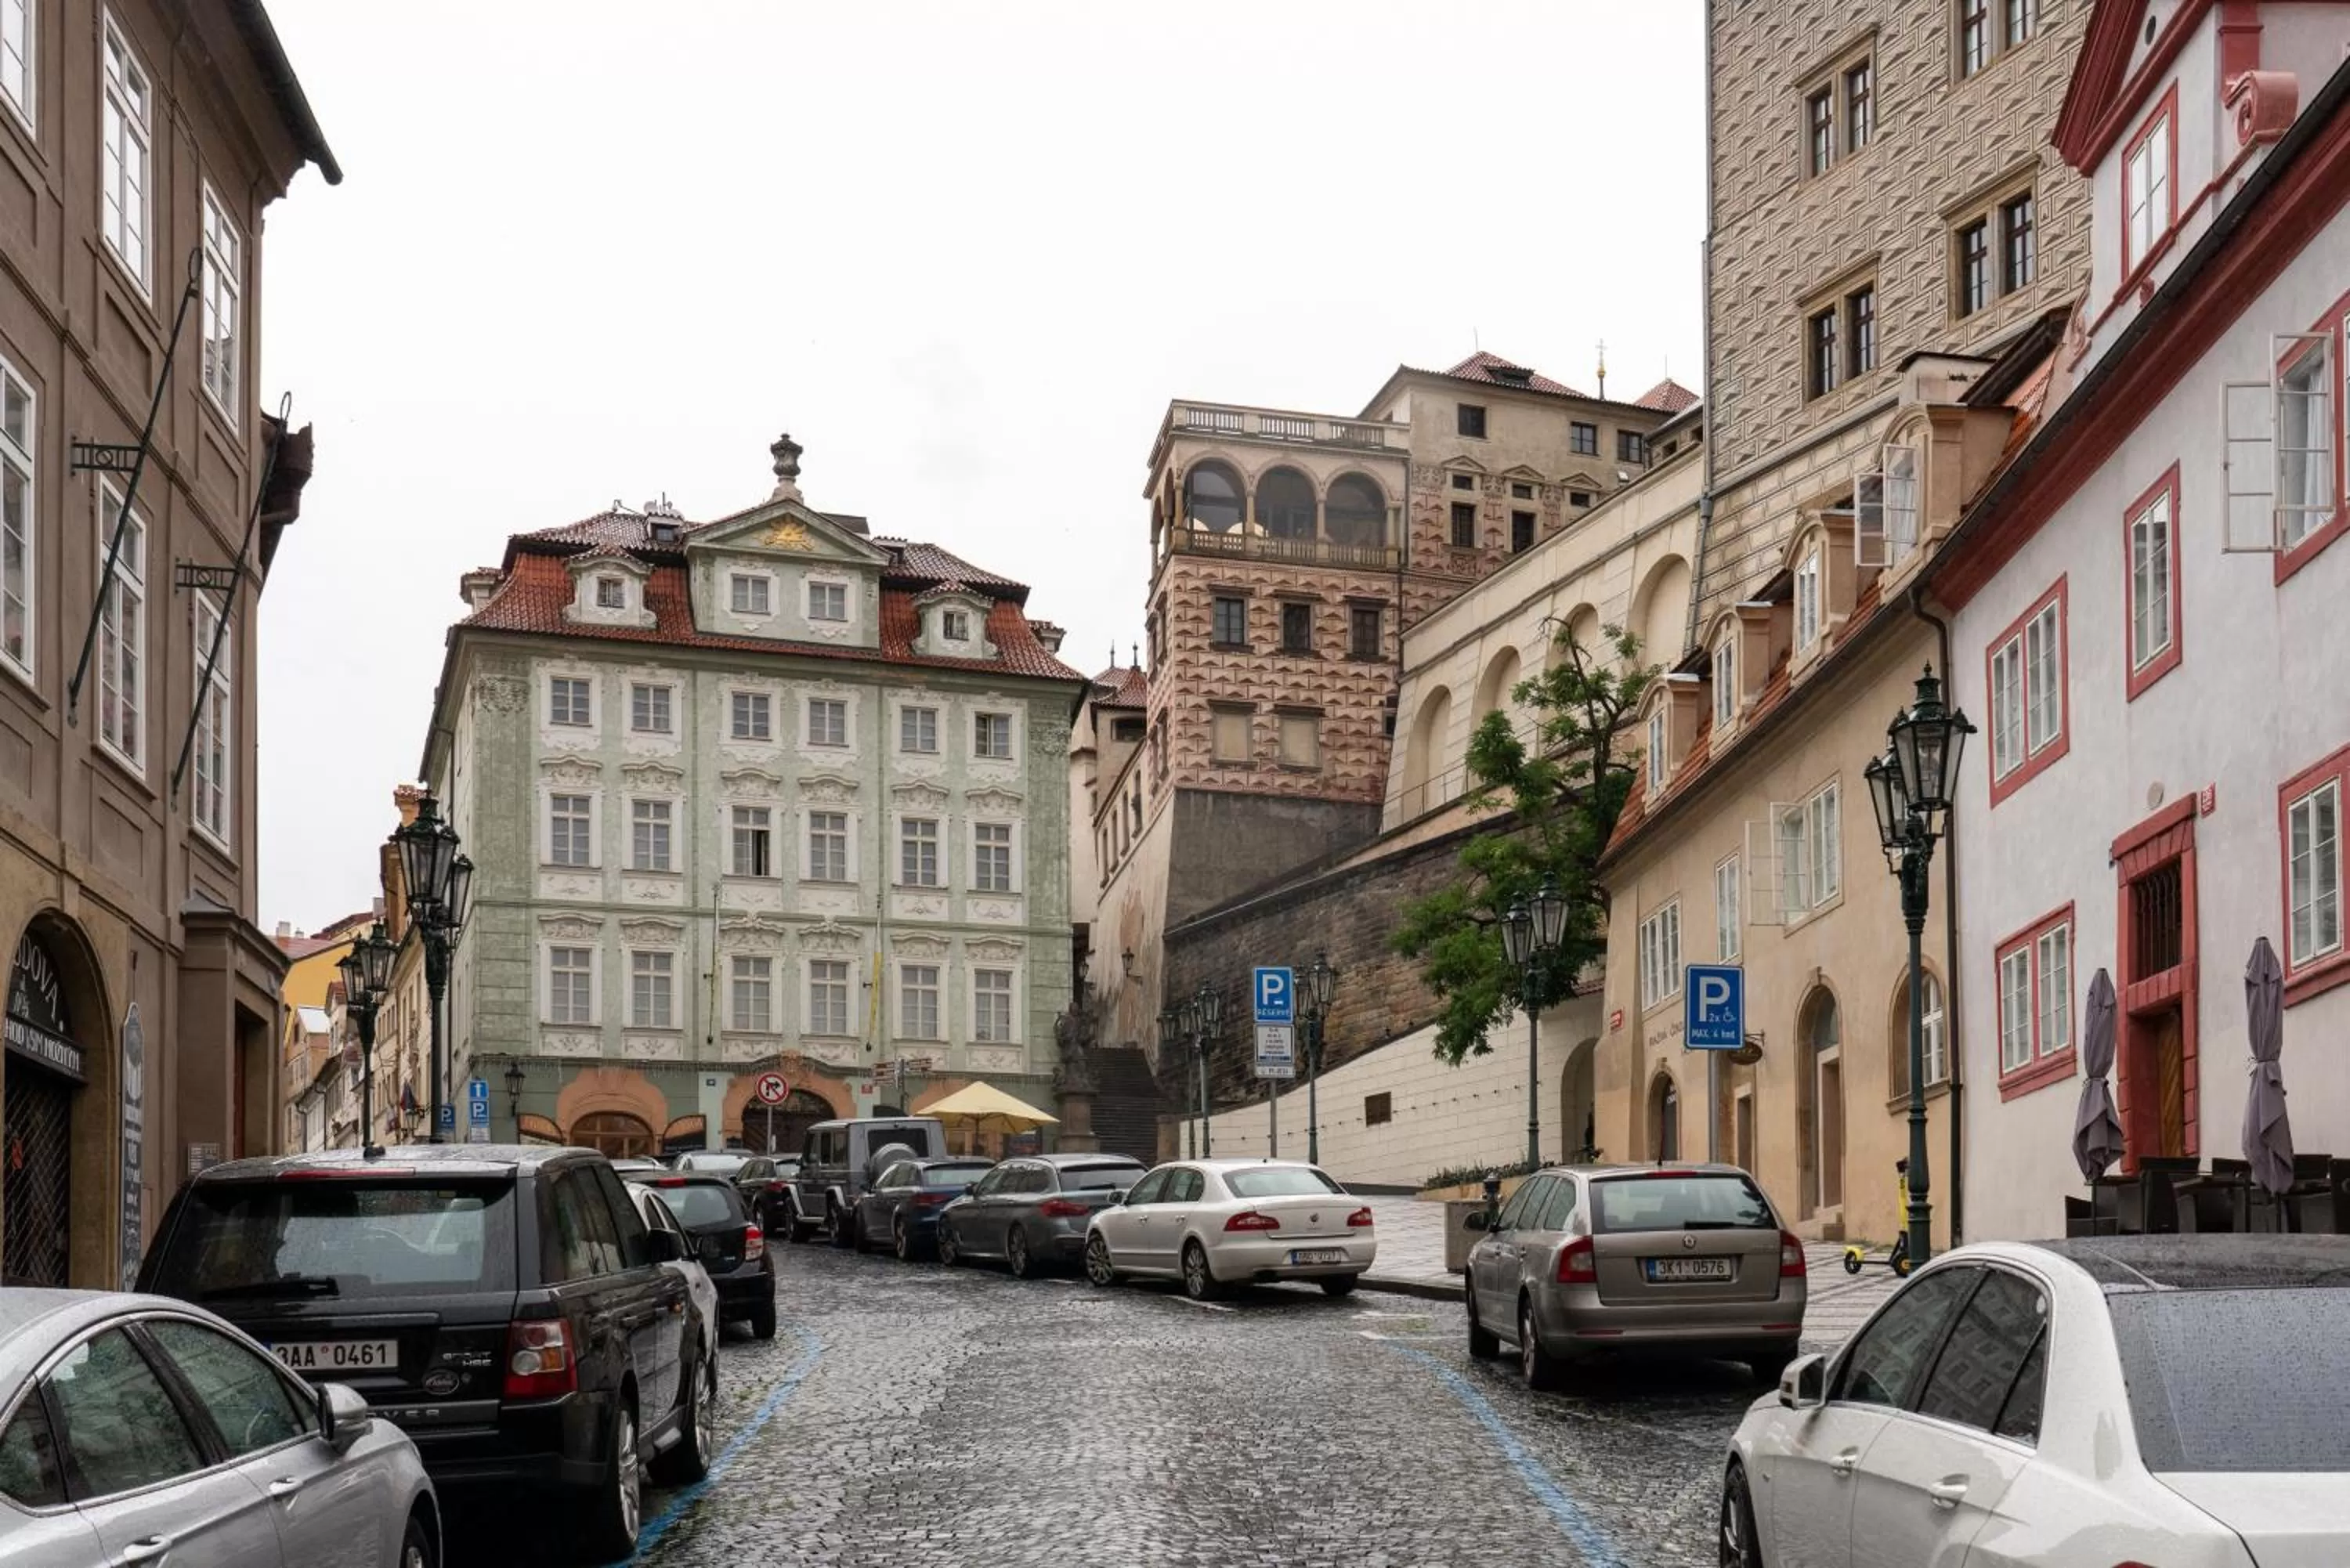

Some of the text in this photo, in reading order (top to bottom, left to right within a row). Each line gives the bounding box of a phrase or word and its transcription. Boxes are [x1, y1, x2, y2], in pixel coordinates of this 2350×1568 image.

[1262, 974, 1284, 1005] P
[1698, 977, 1730, 1022] P
[441, 1107, 452, 1122] P
[472, 1102, 485, 1118] P
[1658, 1260, 1724, 1274] 3K1 0576
[334, 1343, 387, 1366] 0461
